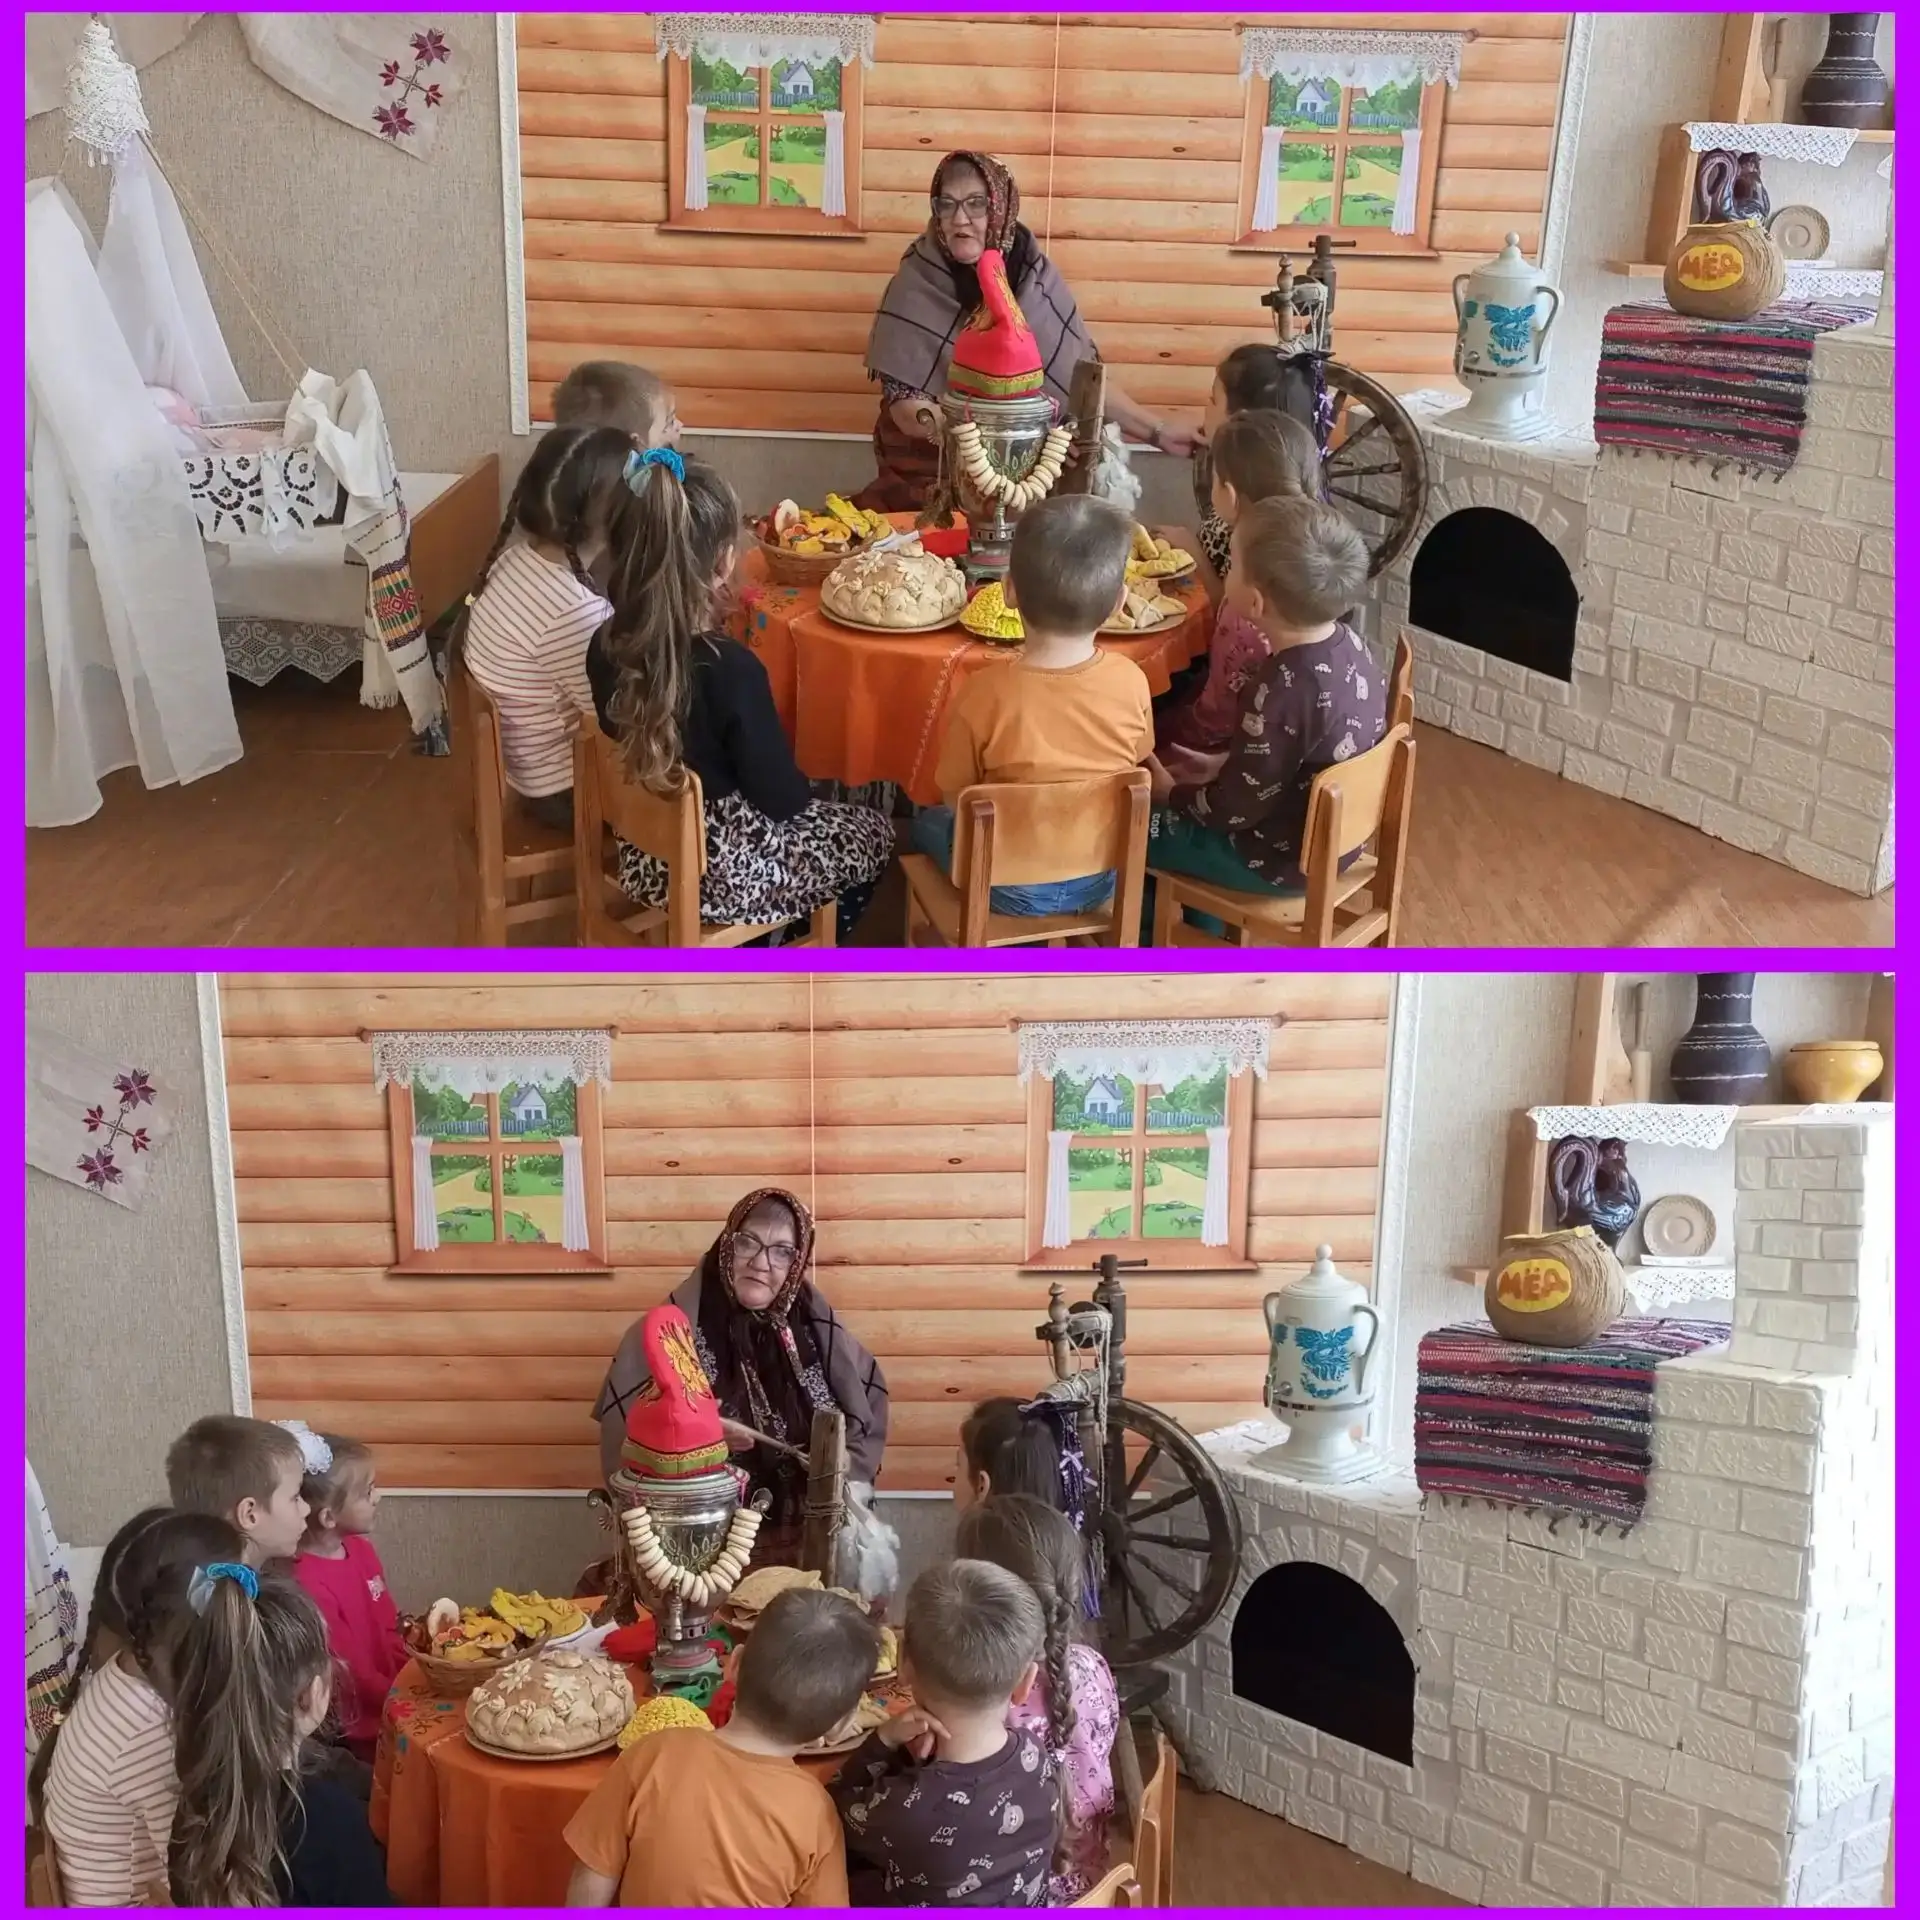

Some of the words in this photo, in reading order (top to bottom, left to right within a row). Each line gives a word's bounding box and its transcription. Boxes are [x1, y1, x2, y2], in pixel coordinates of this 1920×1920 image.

[1498, 1267, 1570, 1301] МЁД
[935, 1826, 958, 1836] JOY
[929, 1835, 954, 1846] Bring
